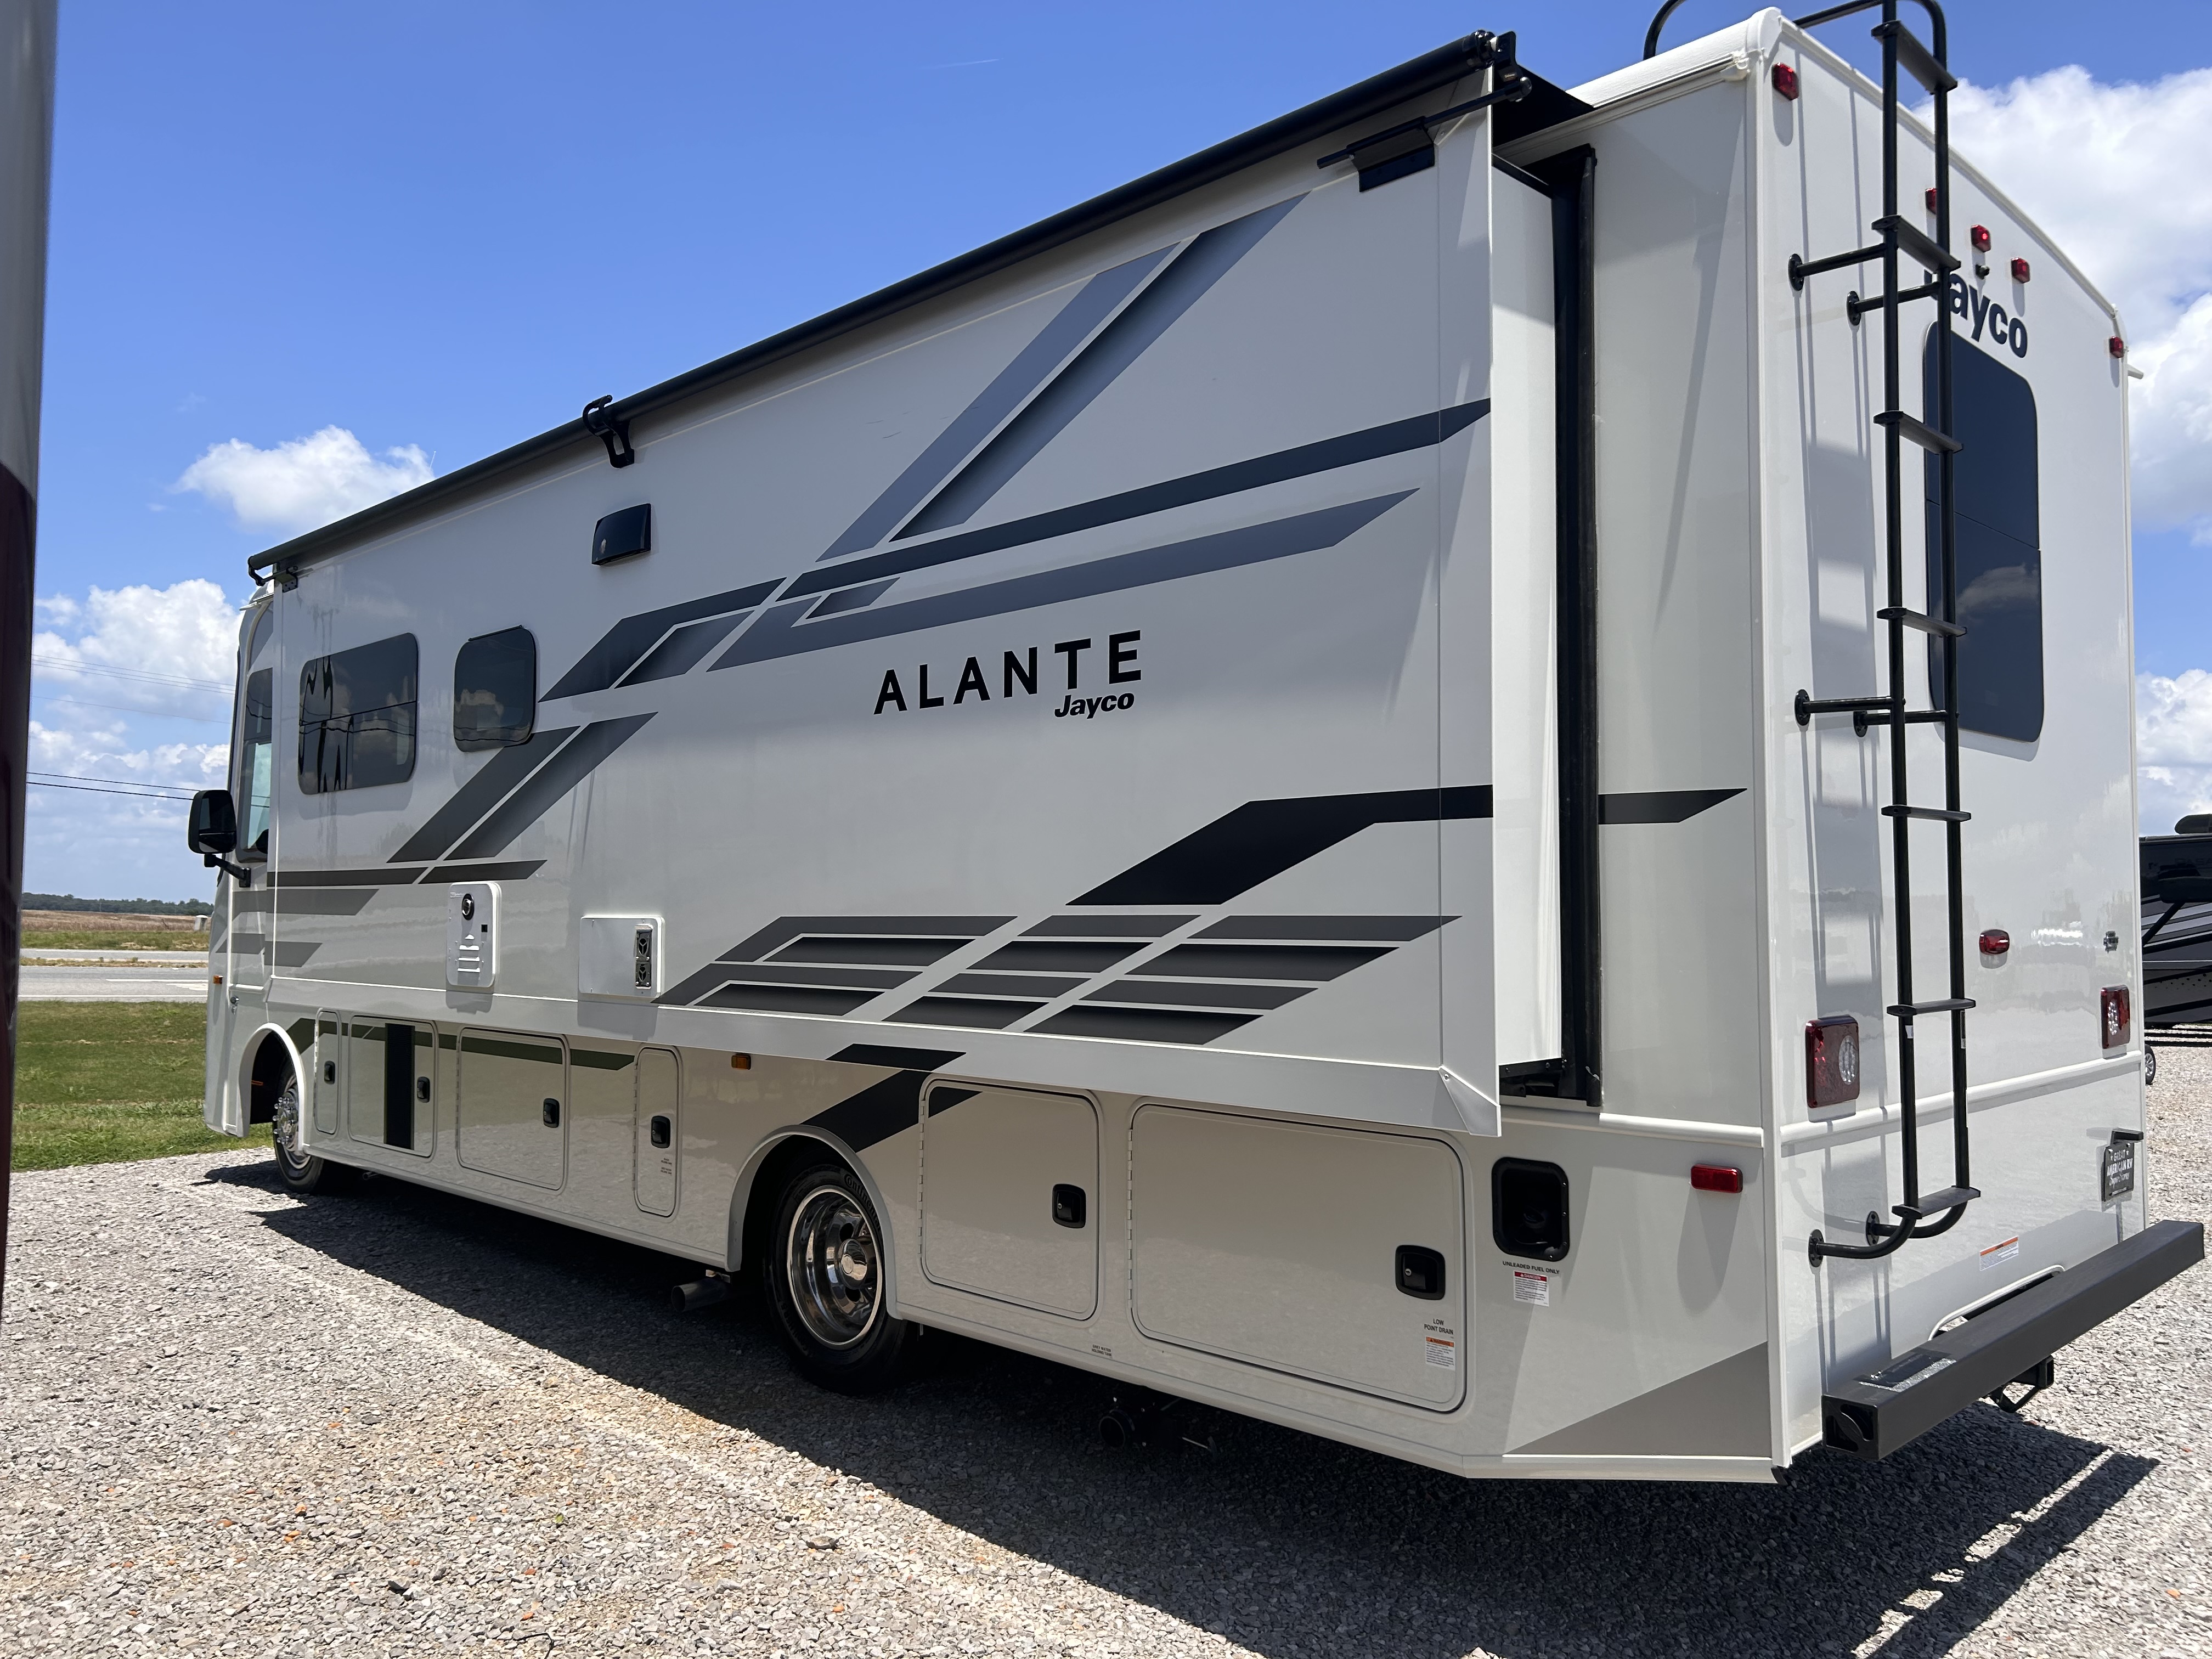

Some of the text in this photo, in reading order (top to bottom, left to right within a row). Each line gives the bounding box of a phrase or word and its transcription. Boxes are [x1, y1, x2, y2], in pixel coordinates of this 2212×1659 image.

[873, 630, 1141, 714] ALANTE
[1054, 693, 1135, 719] Jayco
[1502, 1261, 1531, 1269] UNLEADED
[1438, 1327, 1454, 1335] DRAIN
